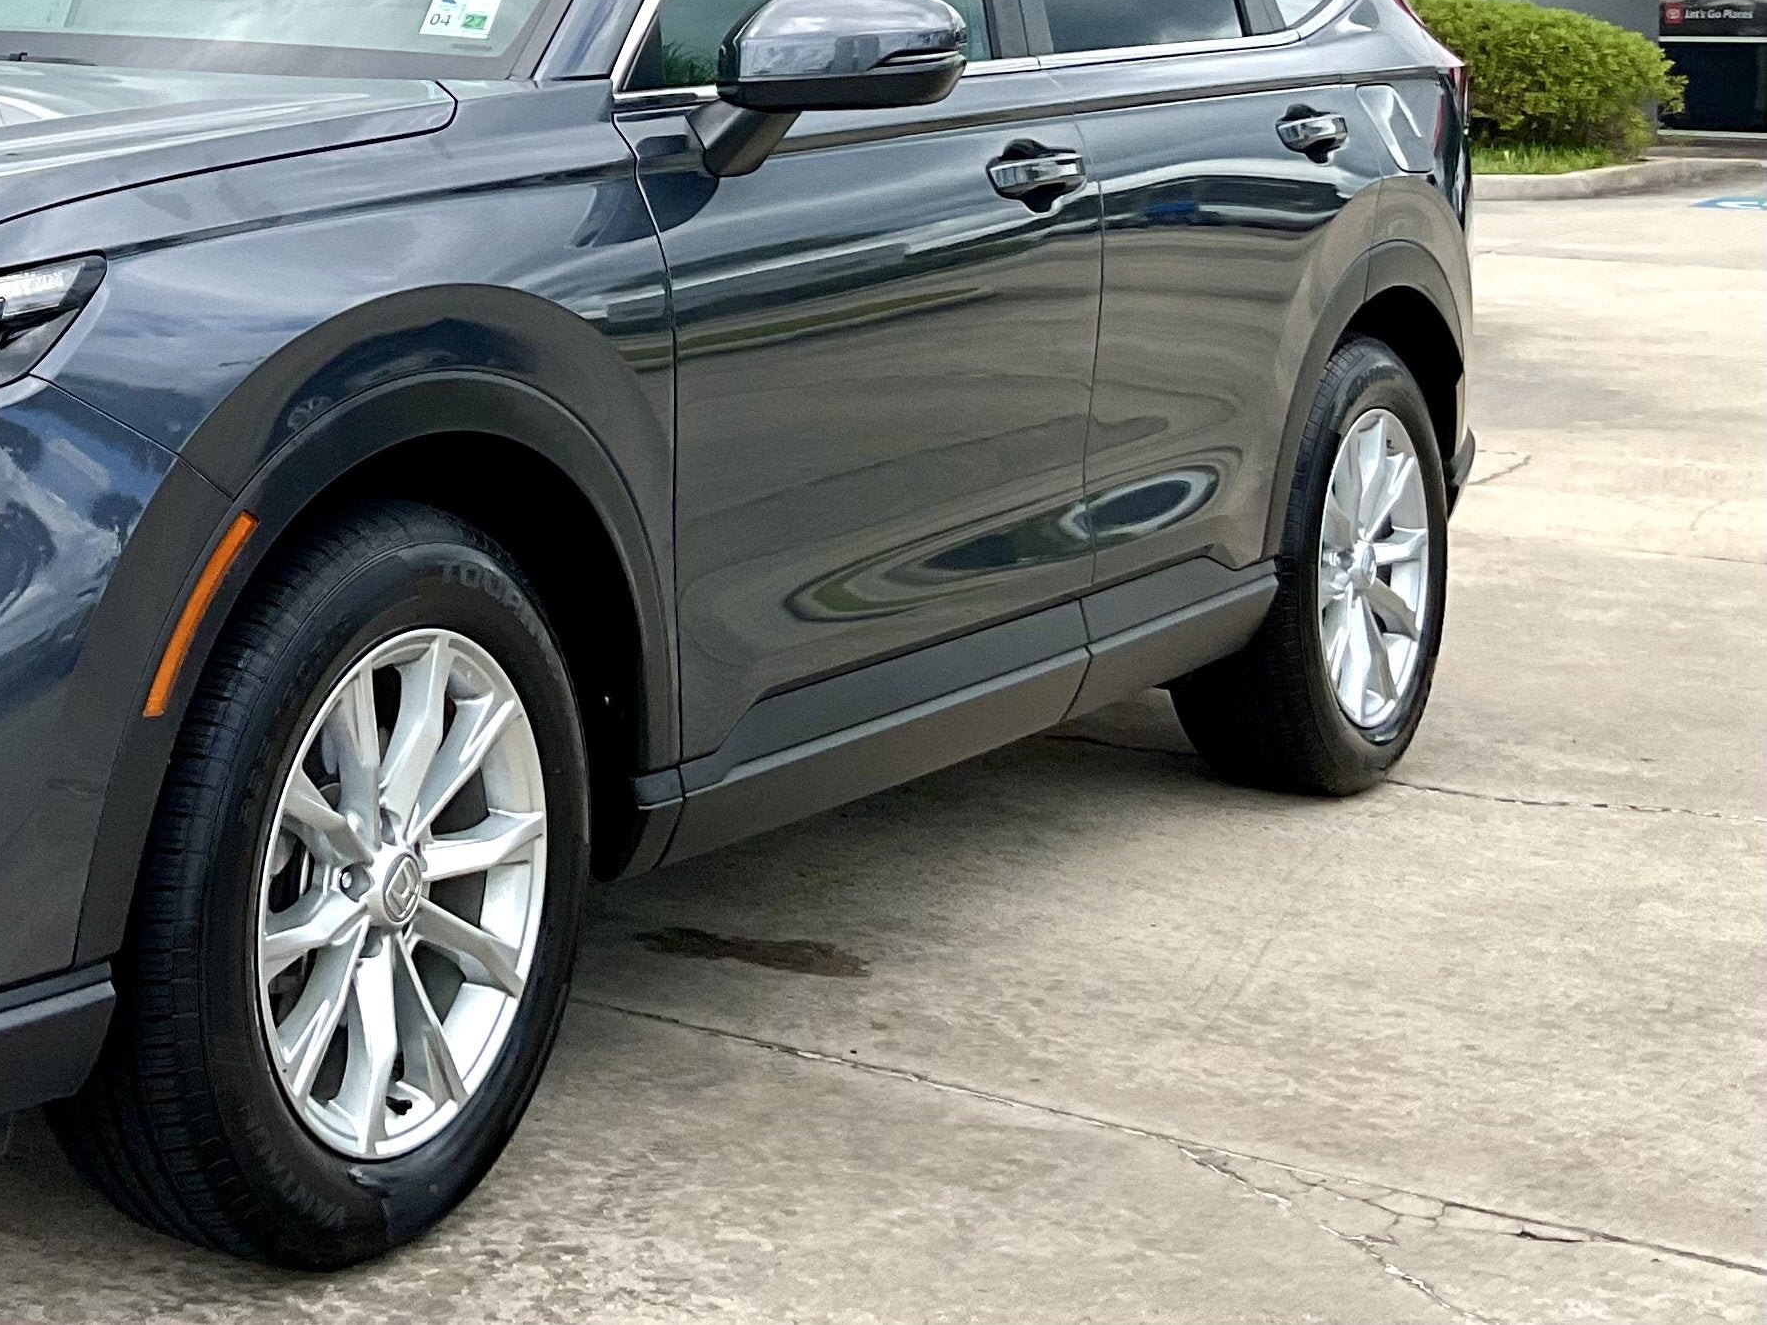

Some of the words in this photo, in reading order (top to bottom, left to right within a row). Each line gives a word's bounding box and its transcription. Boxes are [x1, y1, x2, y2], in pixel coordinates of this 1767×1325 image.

[1706, 9, 1722, 19] Go
[430, 13, 451, 26] 04
[461, 14, 488, 29] 27
